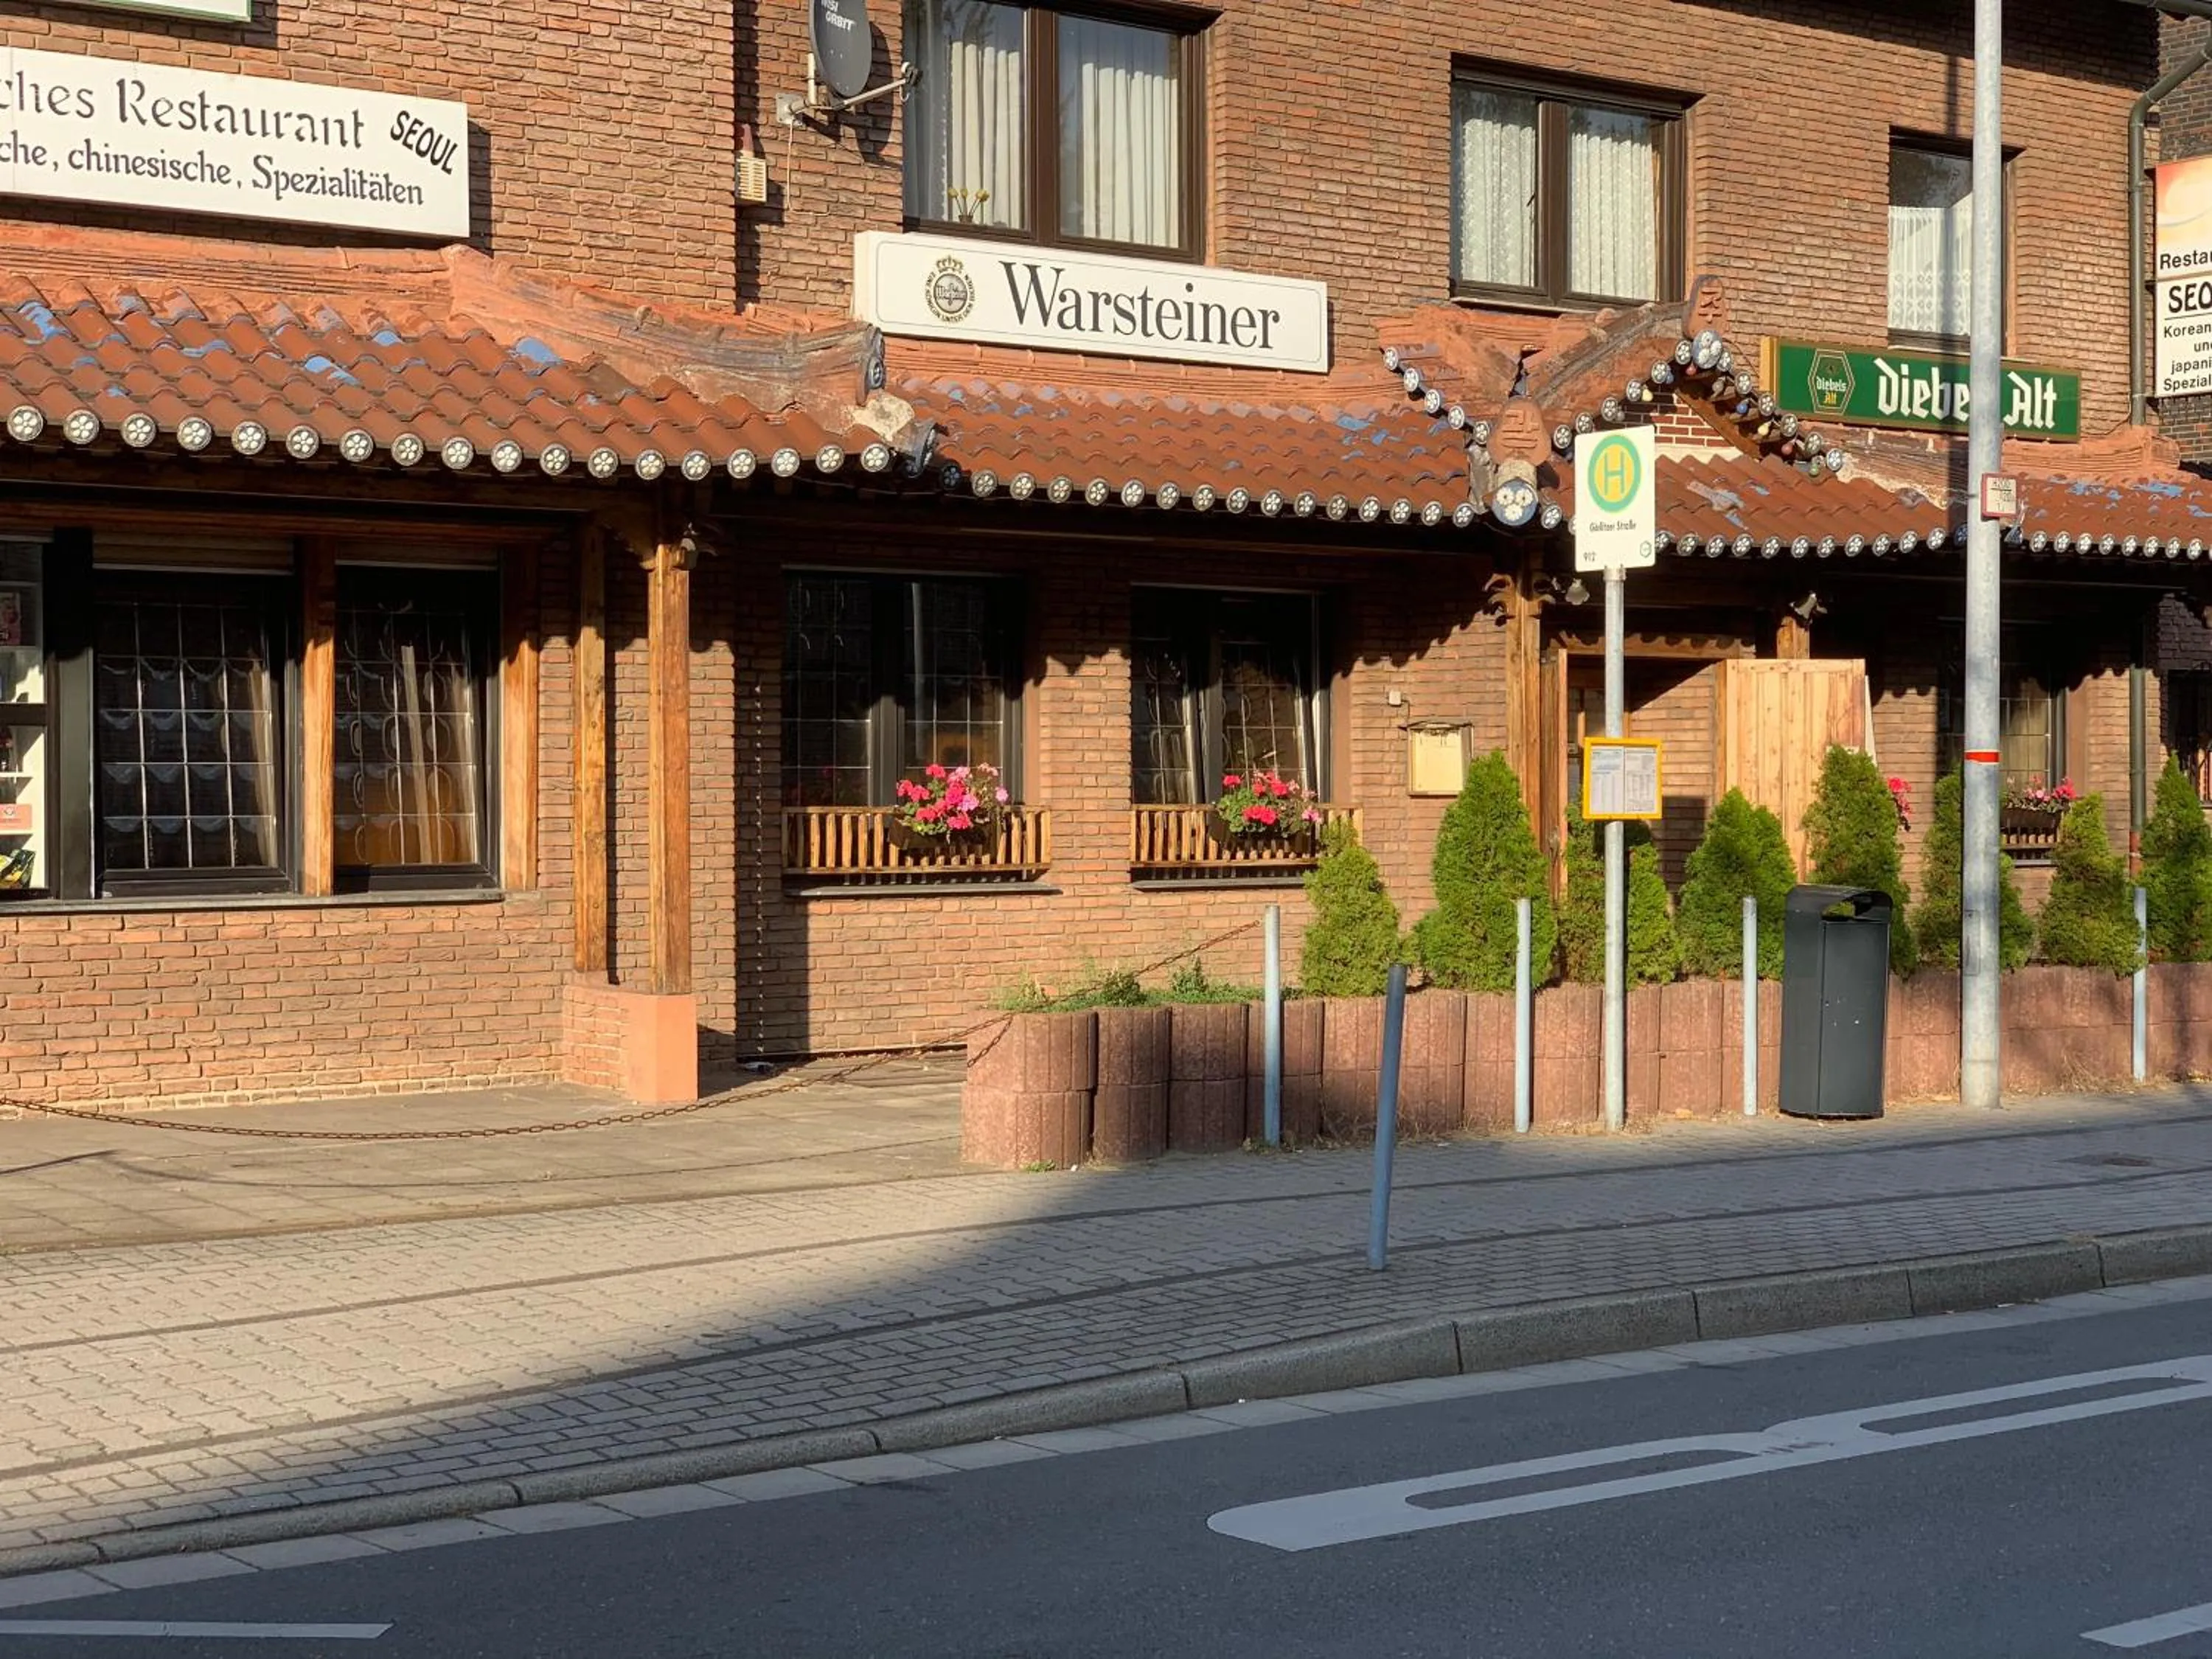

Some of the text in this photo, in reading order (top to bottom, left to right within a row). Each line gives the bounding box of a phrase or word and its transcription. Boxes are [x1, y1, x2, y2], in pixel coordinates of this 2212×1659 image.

[826, 10, 856, 31] ORBIT
[116, 78, 364, 148] Restaurant
[390, 110, 458, 175] SEOUL
[251, 154, 423, 205] Spezialitäten
[2160, 250, 2212, 270] Resta
[998, 261, 1280, 349] Warsteiner
[2168, 281, 2212, 313] SEO
[2194, 341, 2212, 352] un
[2003, 371, 2057, 429] Alt
[1604, 451, 1625, 495] H
